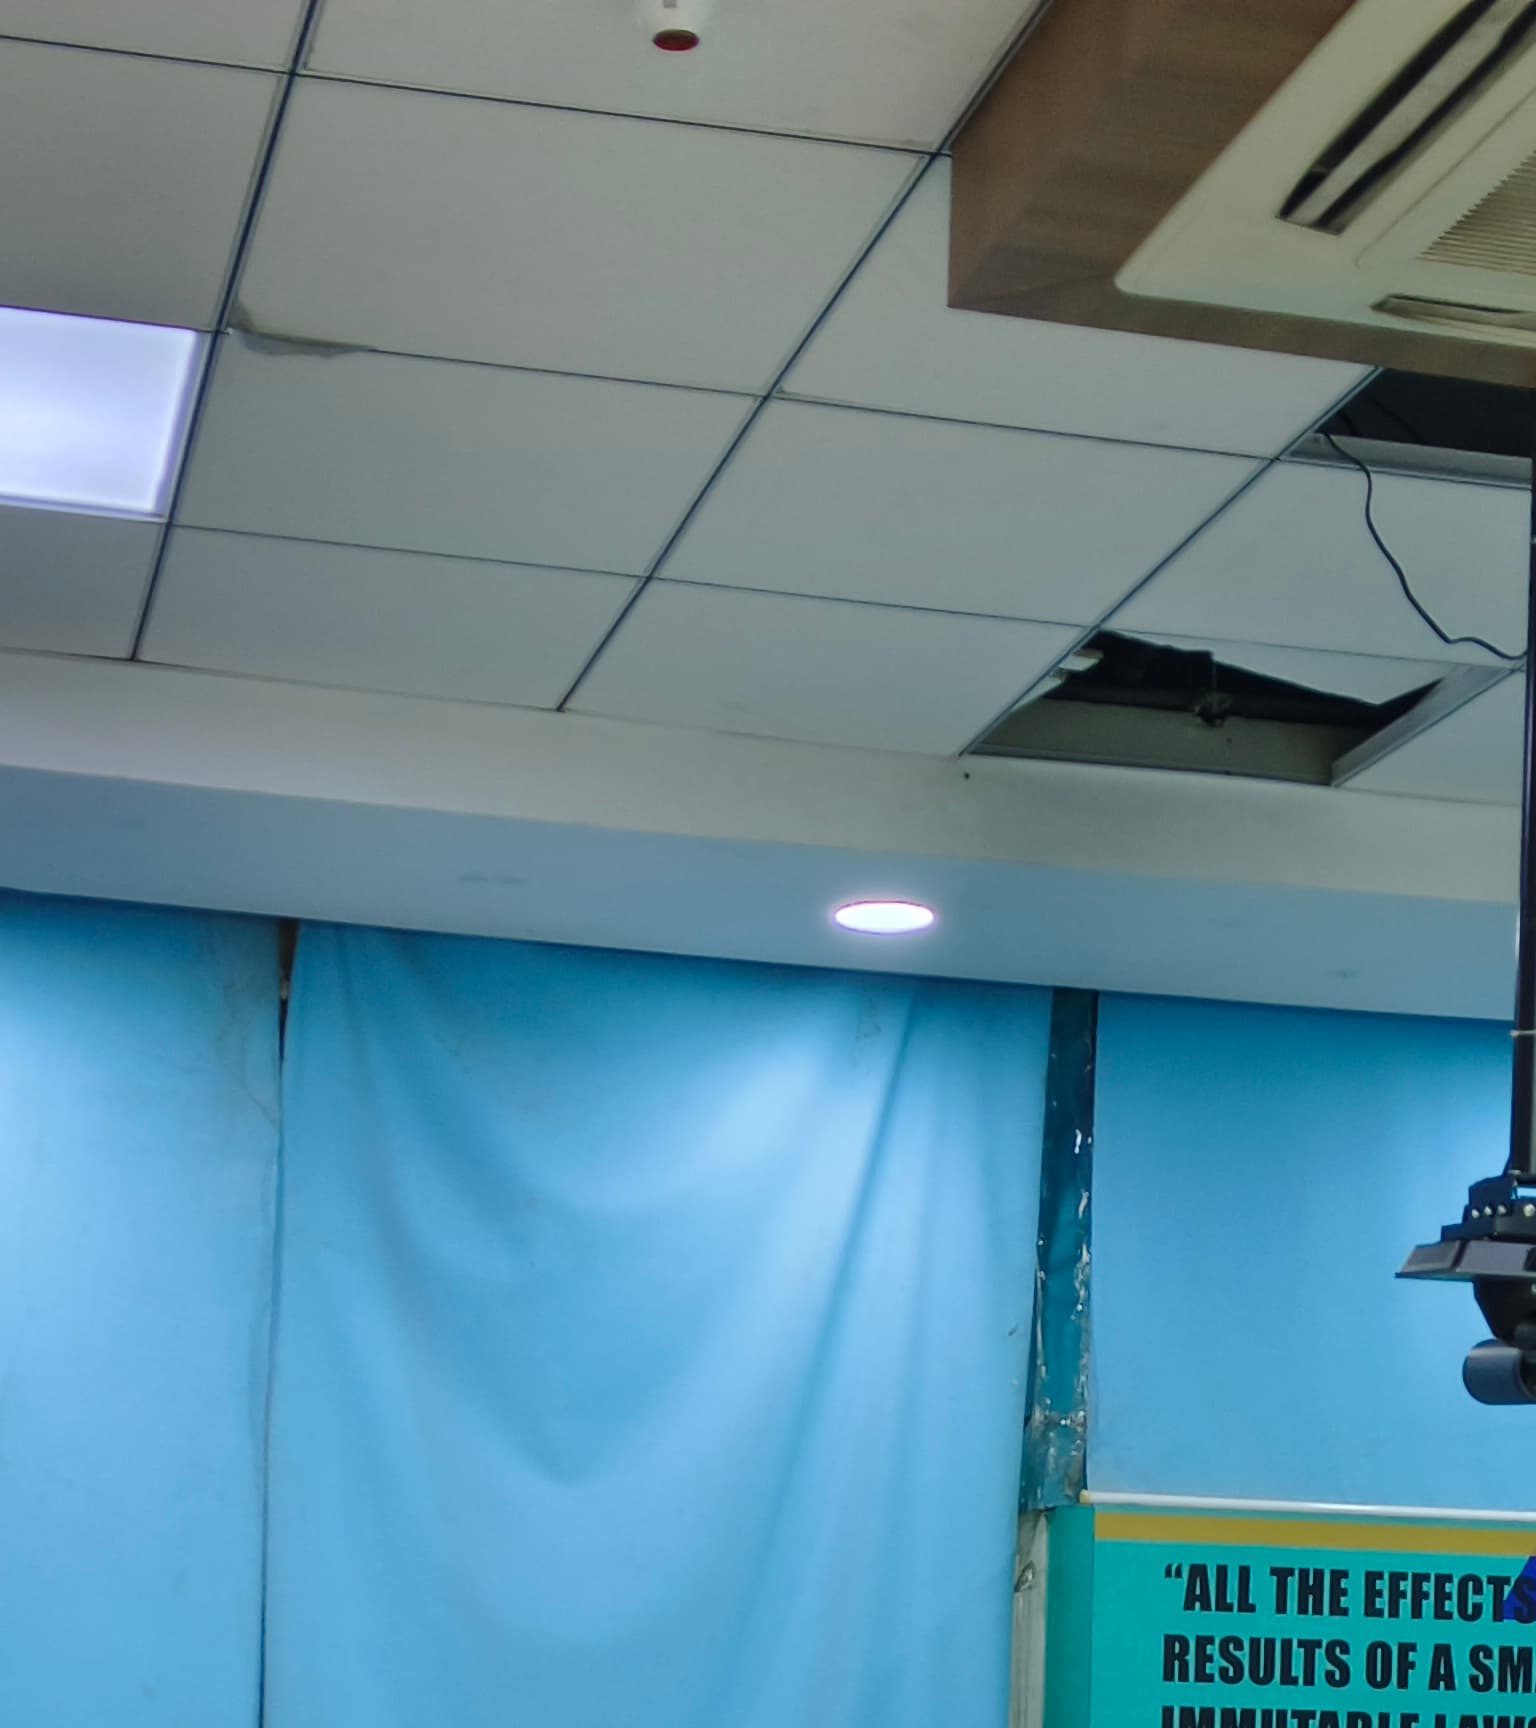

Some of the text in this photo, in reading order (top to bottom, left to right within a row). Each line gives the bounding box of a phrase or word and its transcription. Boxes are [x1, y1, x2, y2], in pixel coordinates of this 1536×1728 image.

[1164, 1563, 1257, 1613] “ALL
[1269, 1566, 1350, 1617] THE
[1162, 1634, 1351, 1688] RESULTS
[1365, 1641, 1417, 1690] OF
[1428, 1643, 1457, 1691] A
